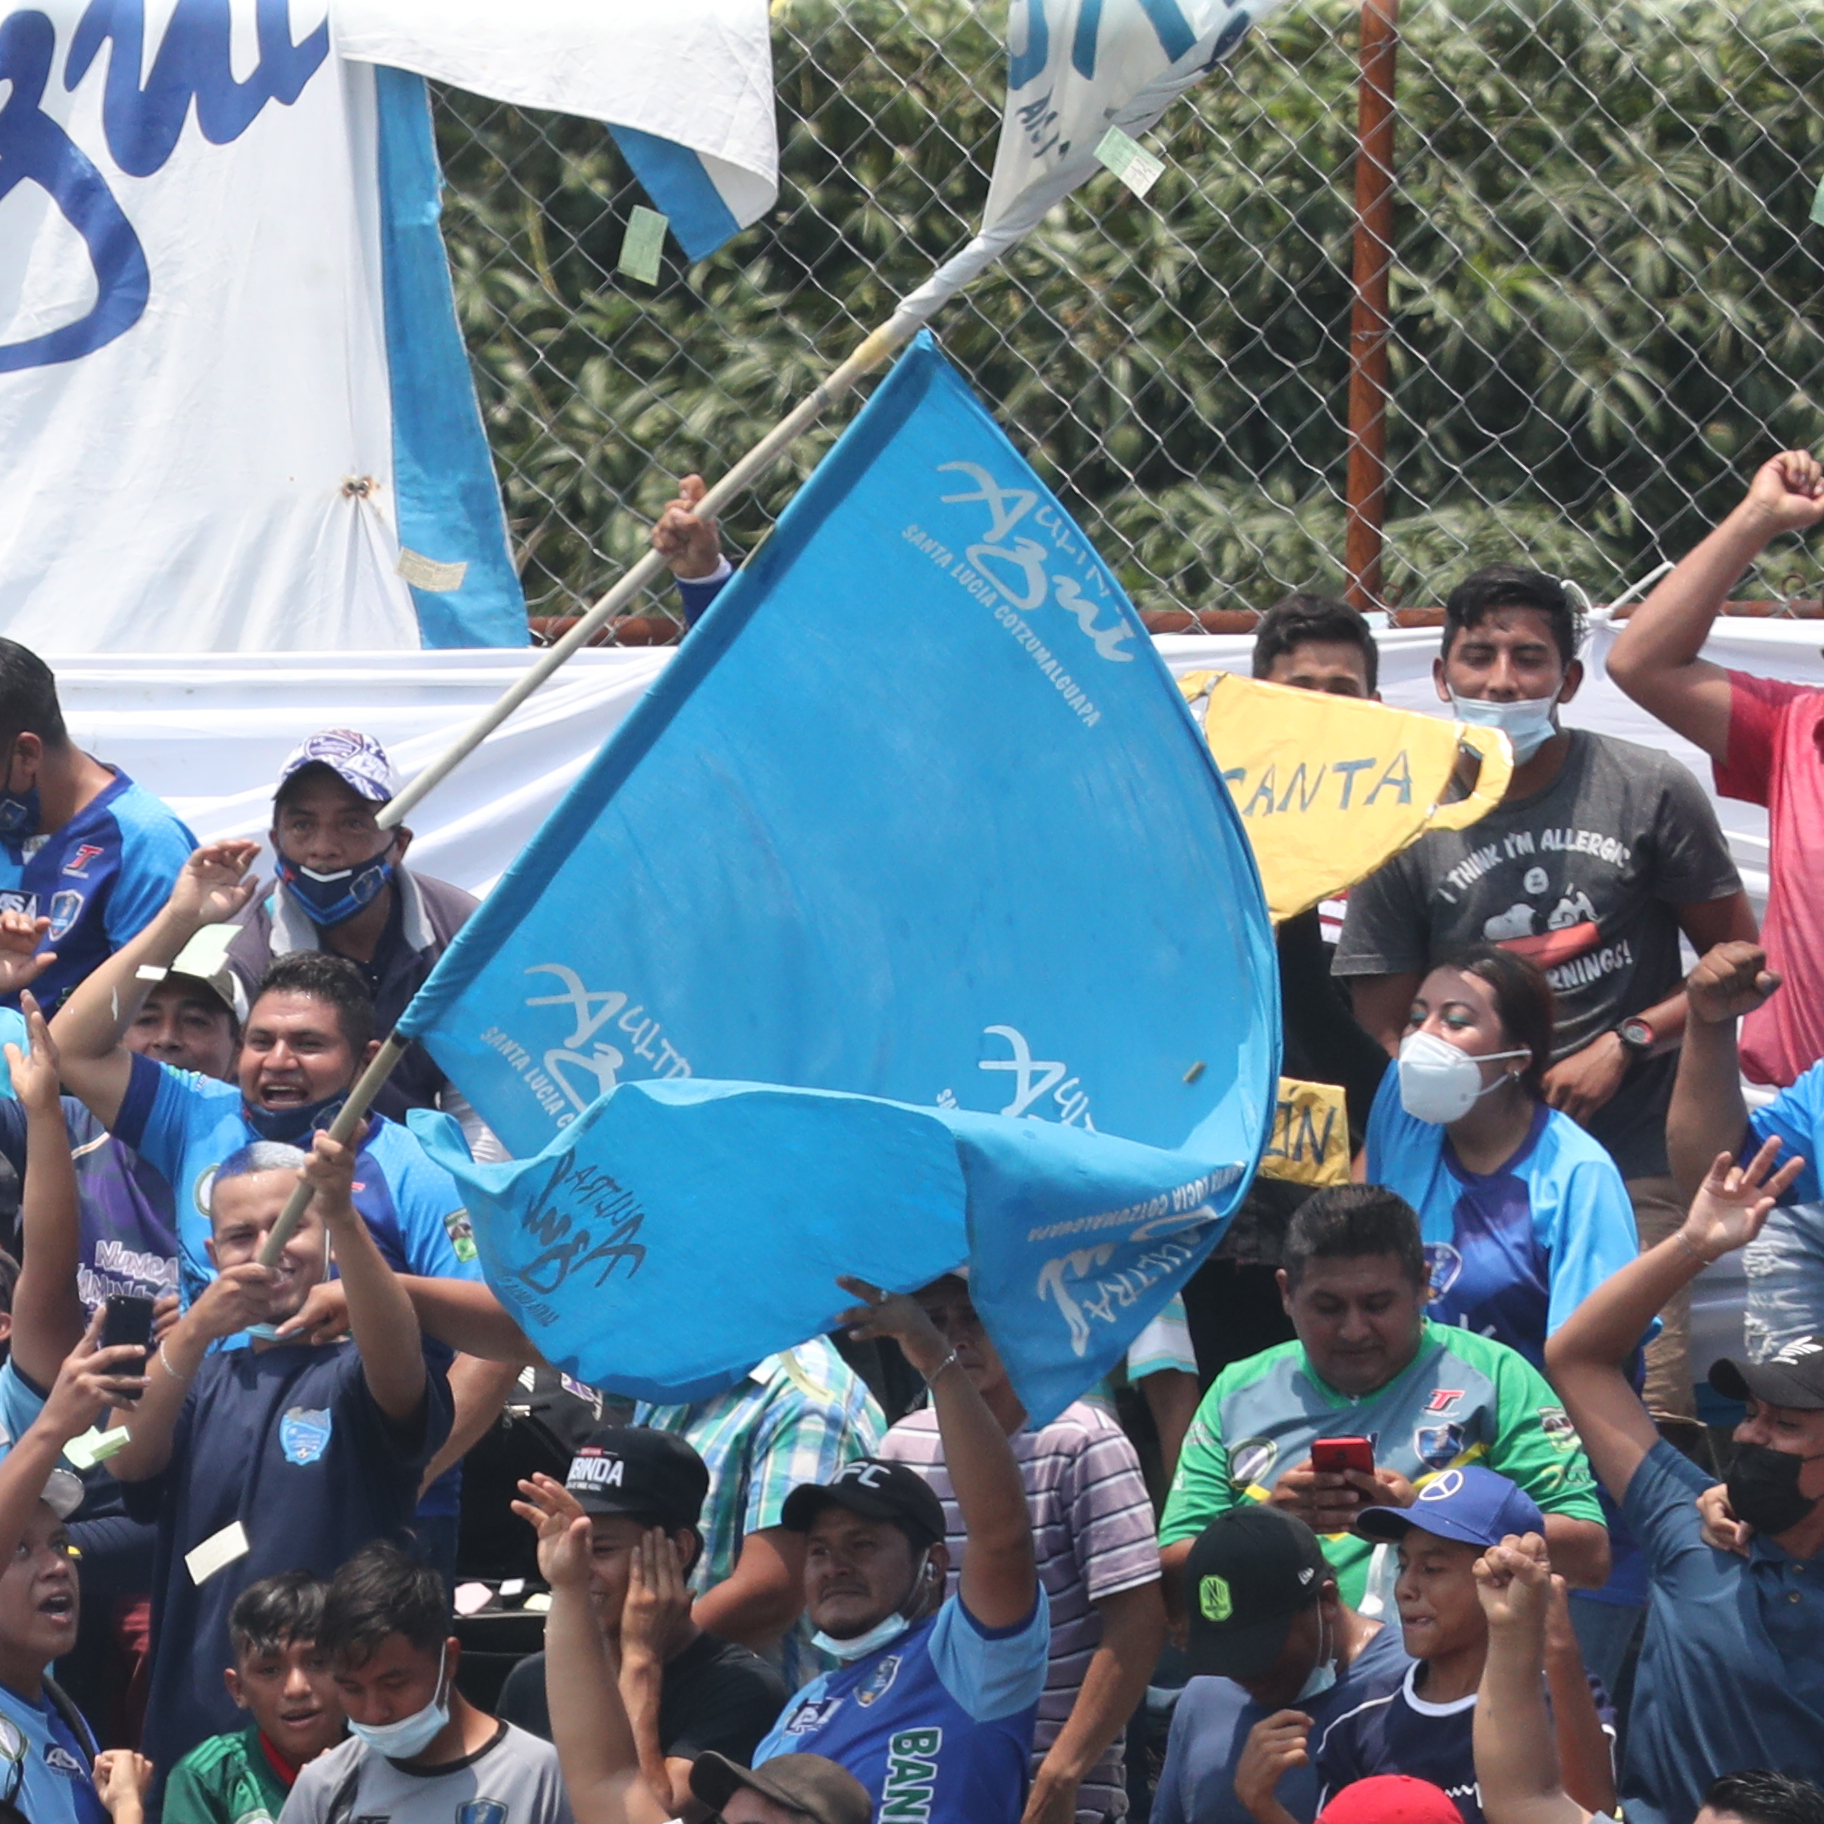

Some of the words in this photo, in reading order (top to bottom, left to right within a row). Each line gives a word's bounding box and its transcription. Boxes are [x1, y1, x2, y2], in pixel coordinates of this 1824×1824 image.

[901, 524, 954, 571] SANTA
[950, 562, 999, 609] LUCIA
[993, 602, 1102, 730] COTZUMALGUAPA
[1447, 841, 1502, 890] THINK
[1504, 830, 1535, 860] I'M
[1541, 826, 1632, 867] ALLERGIC
[1544, 946, 1634, 994] RNINGS!
[481, 1026, 530, 1082] SANTA
[527, 1074, 563, 1117] LUCIA
[95, 1239, 180, 1286] NUNCA
